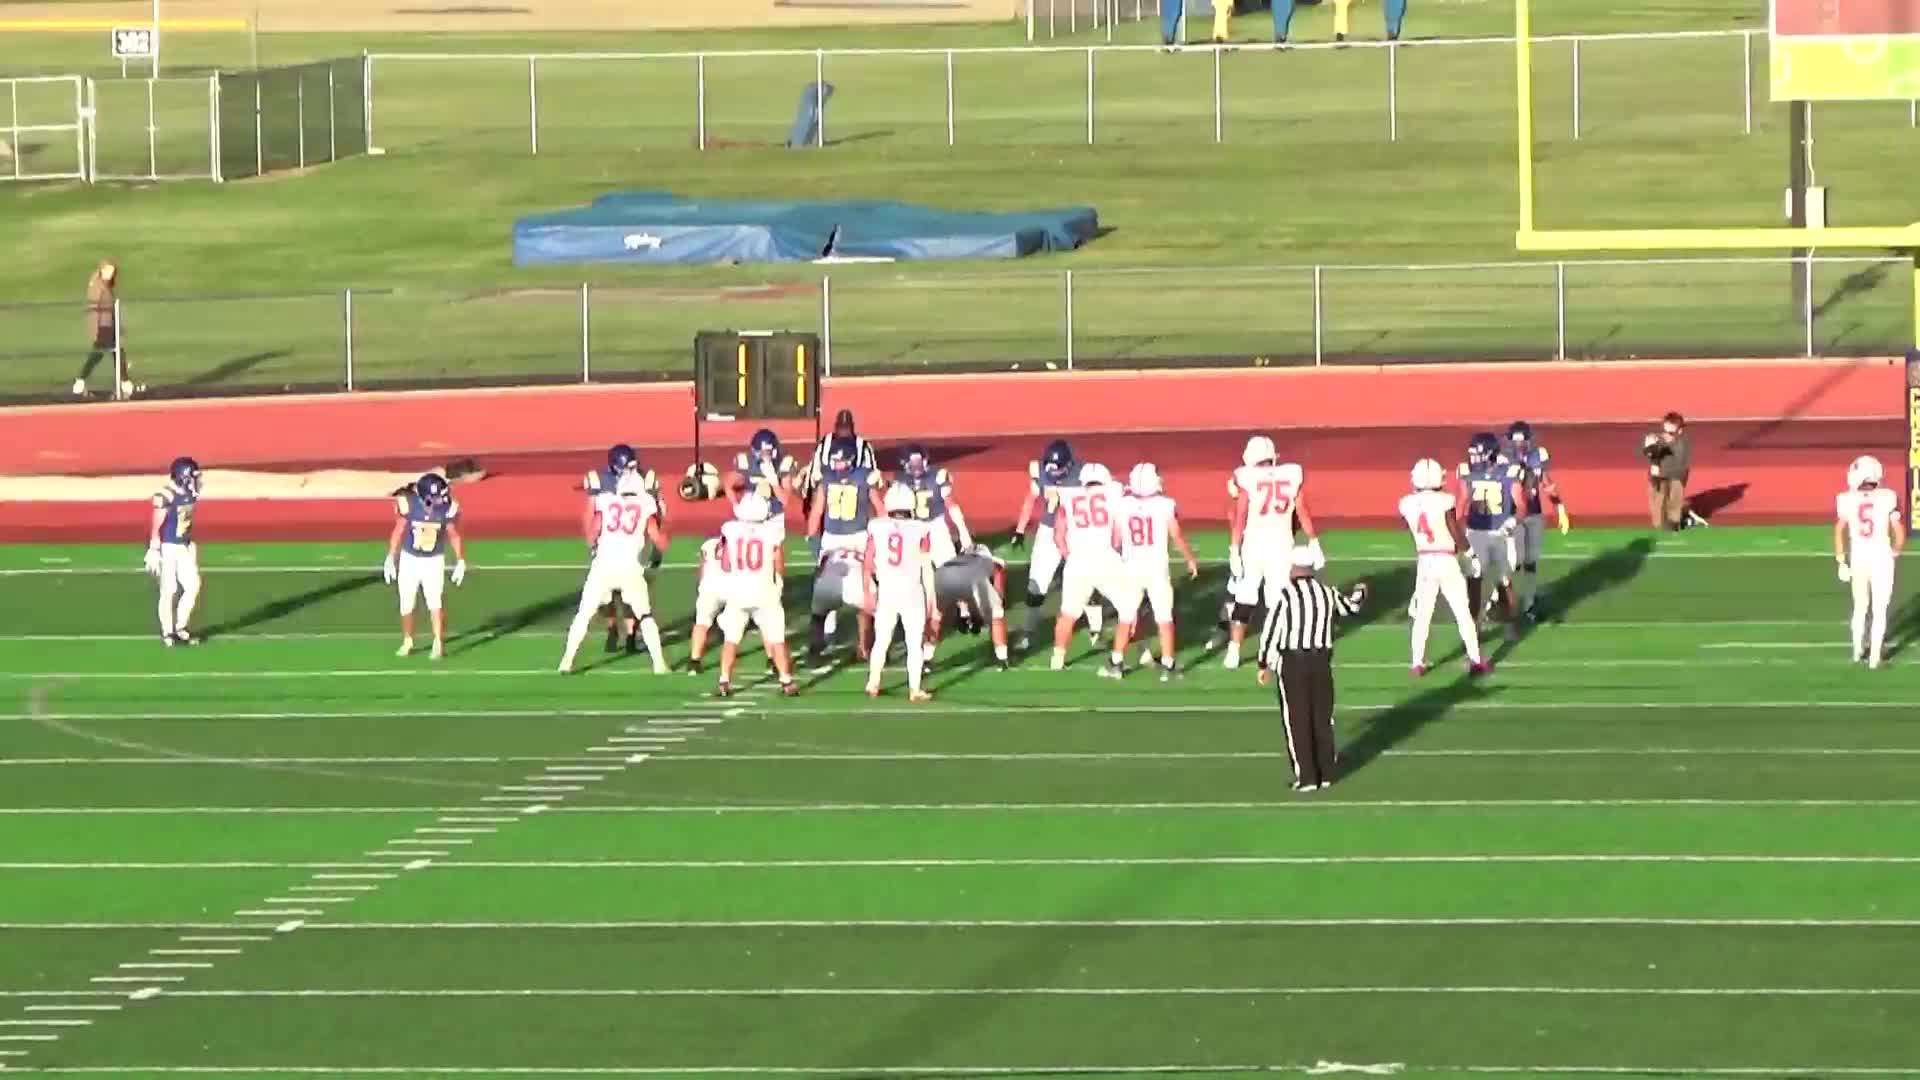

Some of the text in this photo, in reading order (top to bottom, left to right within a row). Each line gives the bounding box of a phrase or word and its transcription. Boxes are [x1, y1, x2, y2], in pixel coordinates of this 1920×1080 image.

[1072, 493, 1109, 528] 56
[1256, 481, 1291, 515] 75
[607, 503, 641, 535] 33
[1128, 516, 1155, 546] 81
[1416, 512, 1435, 544] 4
[1857, 503, 1874, 538] 5
[736, 537, 763, 572] 10
[887, 532, 904, 566] 9
